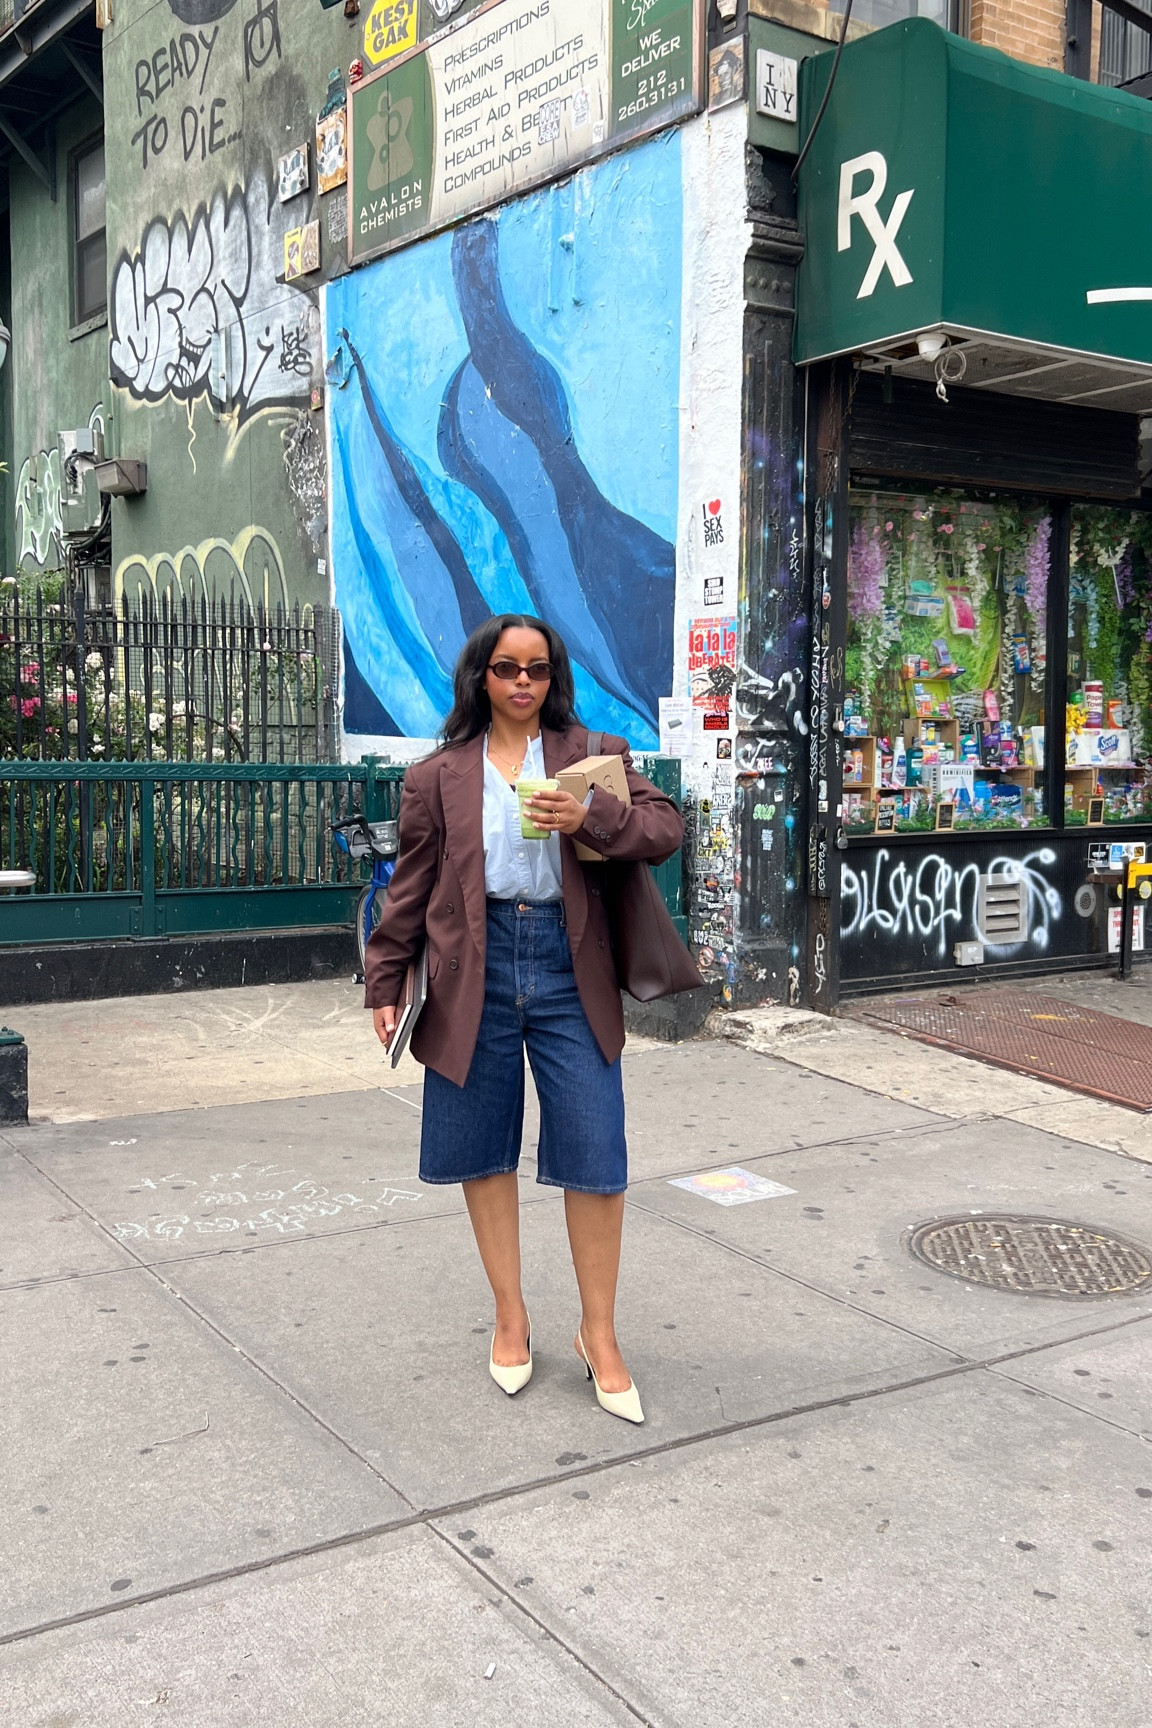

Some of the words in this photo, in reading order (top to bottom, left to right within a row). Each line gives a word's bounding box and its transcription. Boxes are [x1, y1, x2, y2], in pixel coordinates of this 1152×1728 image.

[372, 19, 409, 53] GAK
[444, 5, 550, 73] PRESCRIPTIONS
[639, 28, 661, 51] WE
[135, 25, 219, 118] READY
[444, 54, 503, 95] VITAMINS
[621, 35, 680, 78] DELIVER
[766, 63, 774, 86] I
[444, 85, 498, 122] HERBAL
[504, 34, 584, 88] PRODUCTS
[637, 69, 667, 96] 212
[444, 118, 479, 147] FIRST
[486, 103, 511, 126] AID
[517, 54, 599, 110] PRODUCTS
[131, 114, 168, 170] TO
[444, 136, 495, 170] HEALTH
[502, 125, 514, 140] &
[444, 142, 532, 194] COMPOUNDS
[360, 179, 423, 220] AVALON
[360, 196, 422, 234] CHEMISTS
[702, 503, 707, 520] I
[703, 515, 722, 533] SEX
[704, 529, 724, 548] PAYS
[689, 630, 703, 652] la
[707, 629, 720, 651] la
[723, 628, 736, 651] la
[688, 651, 735, 671] LIBERATE!
[1100, 734, 1116, 750] Scott
